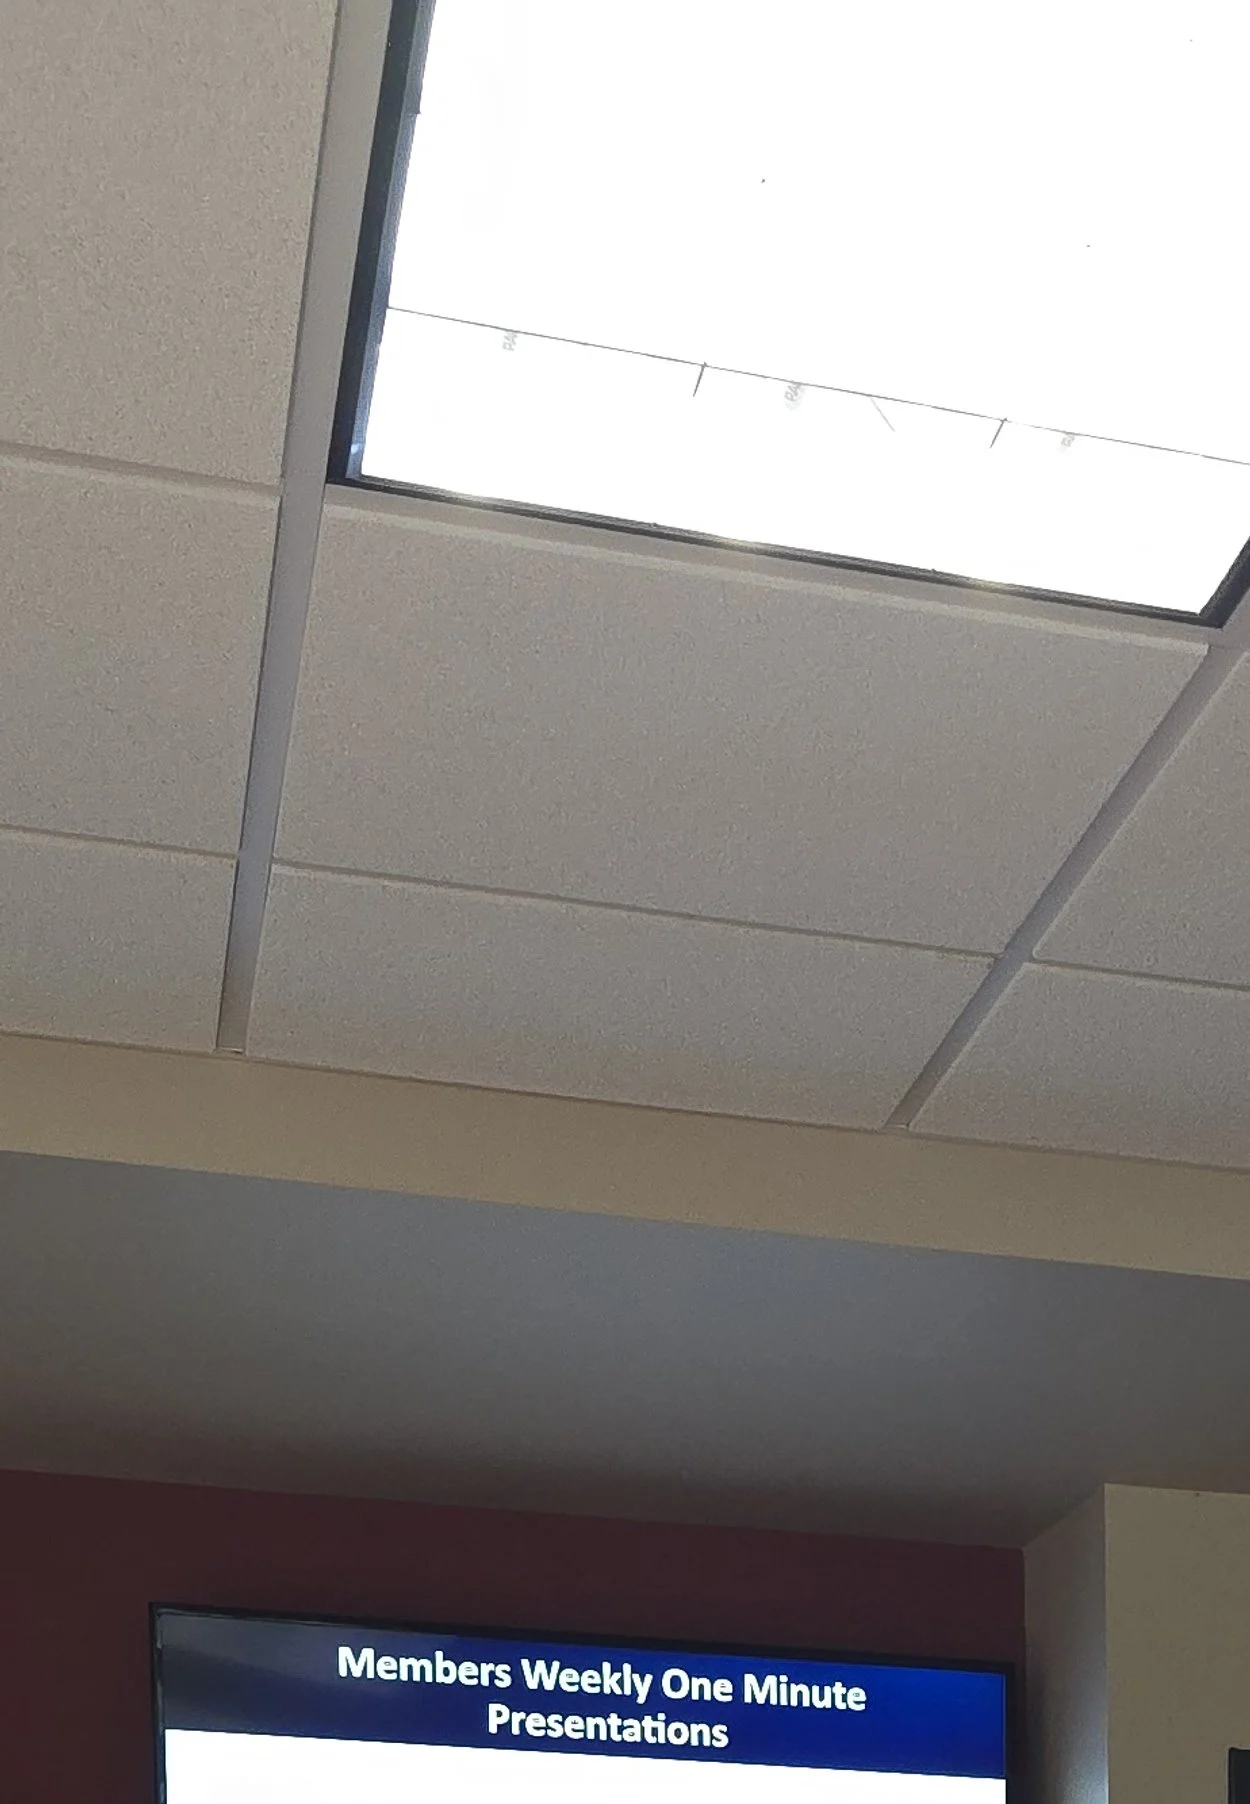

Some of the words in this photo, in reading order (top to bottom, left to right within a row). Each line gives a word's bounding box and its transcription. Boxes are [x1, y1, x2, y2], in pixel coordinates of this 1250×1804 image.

[337, 1646, 512, 1688] Members
[520, 1658, 653, 1704] Weekly
[661, 1667, 733, 1702] One
[743, 1673, 867, 1711] Minute
[487, 1703, 729, 1748] Presentations
